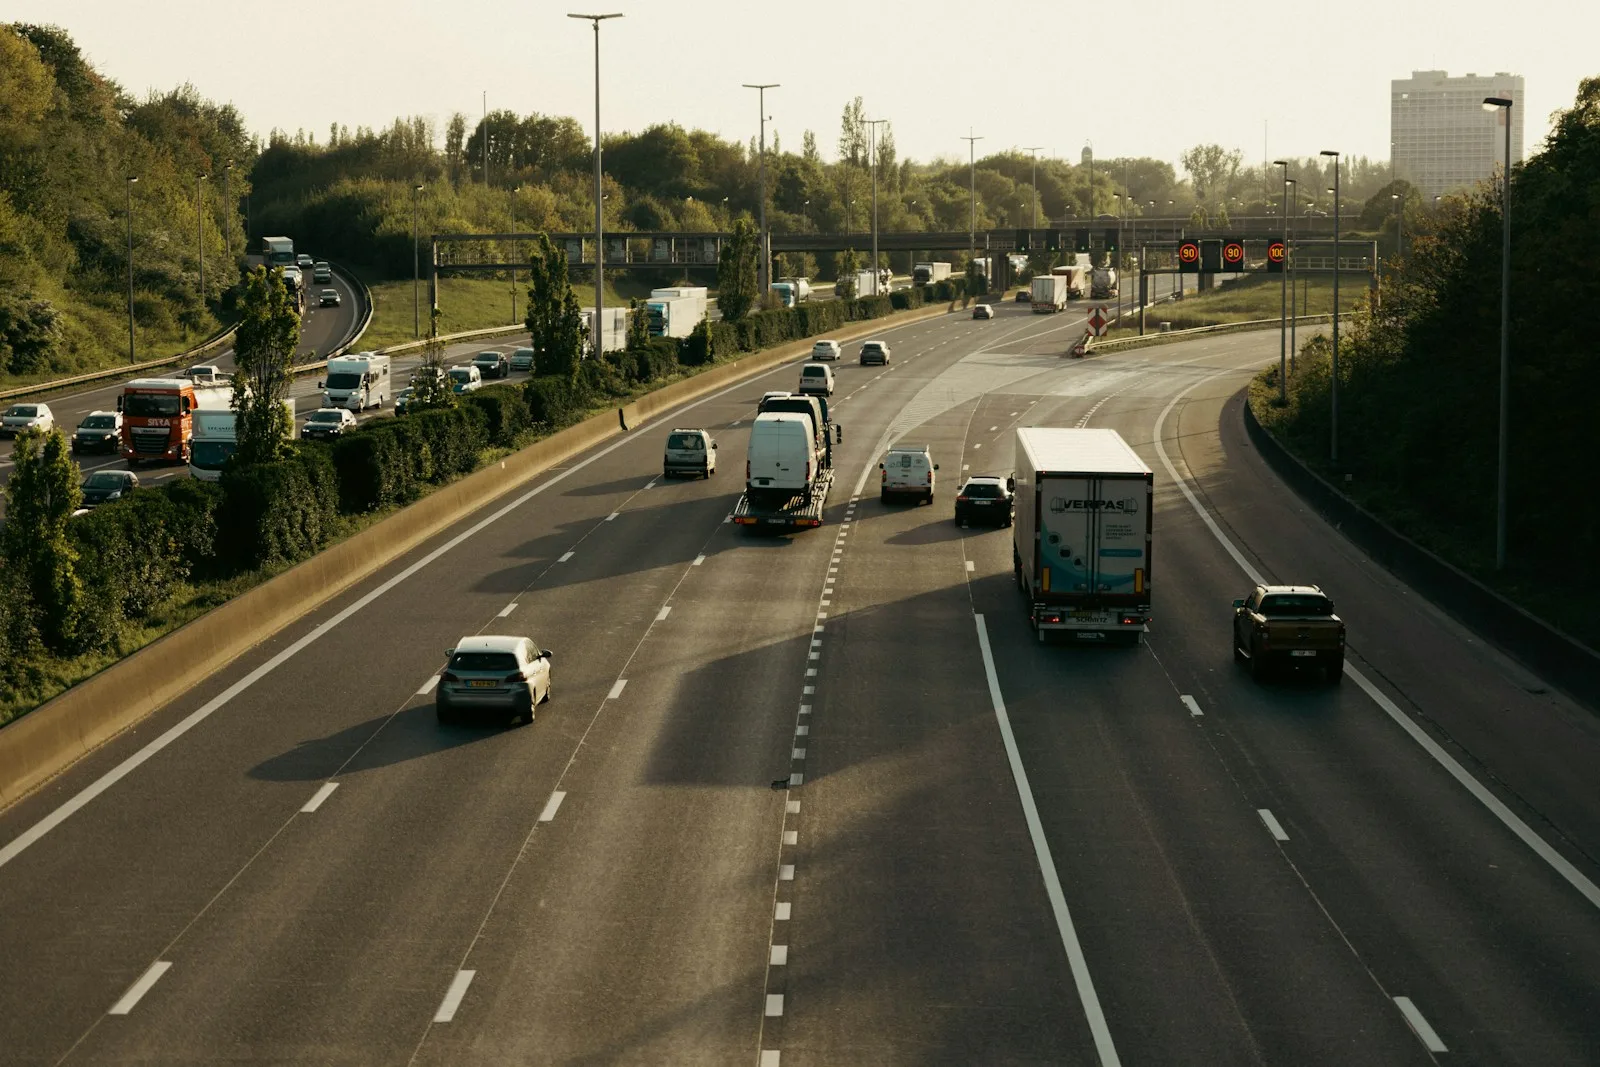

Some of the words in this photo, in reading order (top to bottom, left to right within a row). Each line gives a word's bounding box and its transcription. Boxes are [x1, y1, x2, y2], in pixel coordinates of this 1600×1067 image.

[1183, 248, 1195, 258] 90
[1227, 248, 1239, 258] 90
[1271, 248, 1284, 258] 100
[147, 418, 171, 427] SITRA
[1064, 499, 1124, 510] VERPAS
